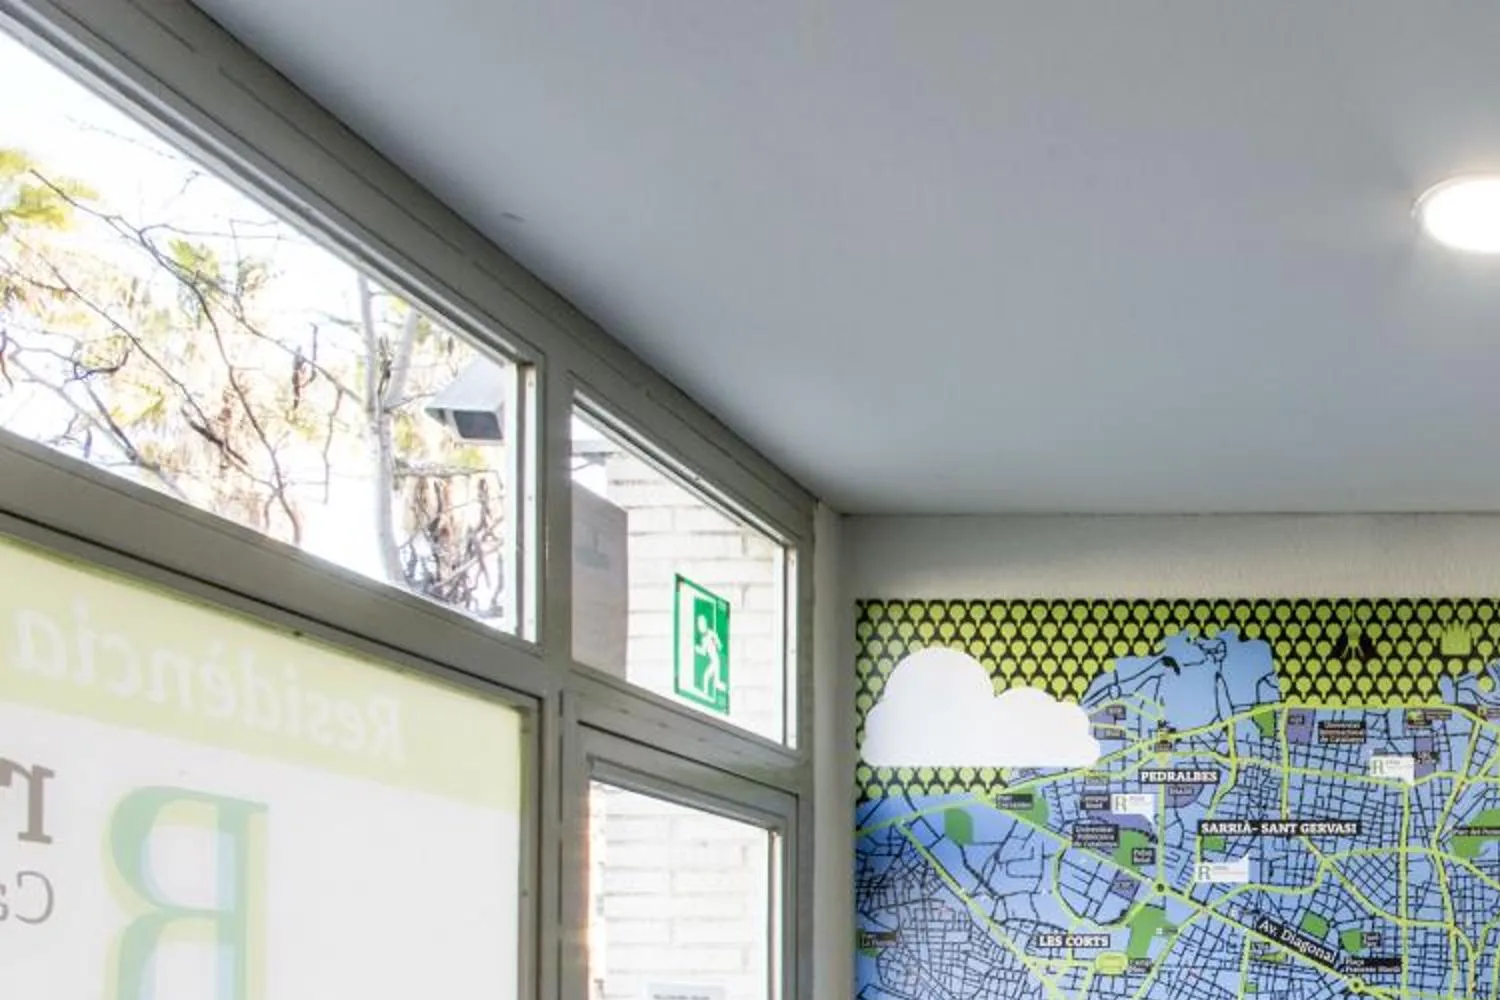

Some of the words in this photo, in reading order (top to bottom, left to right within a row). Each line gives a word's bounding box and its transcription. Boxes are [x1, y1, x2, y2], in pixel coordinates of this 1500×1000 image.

[1141, 771, 1218, 783] PEDRALBES
[1261, 822, 1298, 834] SANT
[1300, 822, 1357, 834] GERVASI
[1039, 935, 1062, 946] LES
[1065, 935, 1110, 946] CORTS
[1259, 919, 1279, 938] Av.
[1281, 928, 1337, 964] Diagonal
